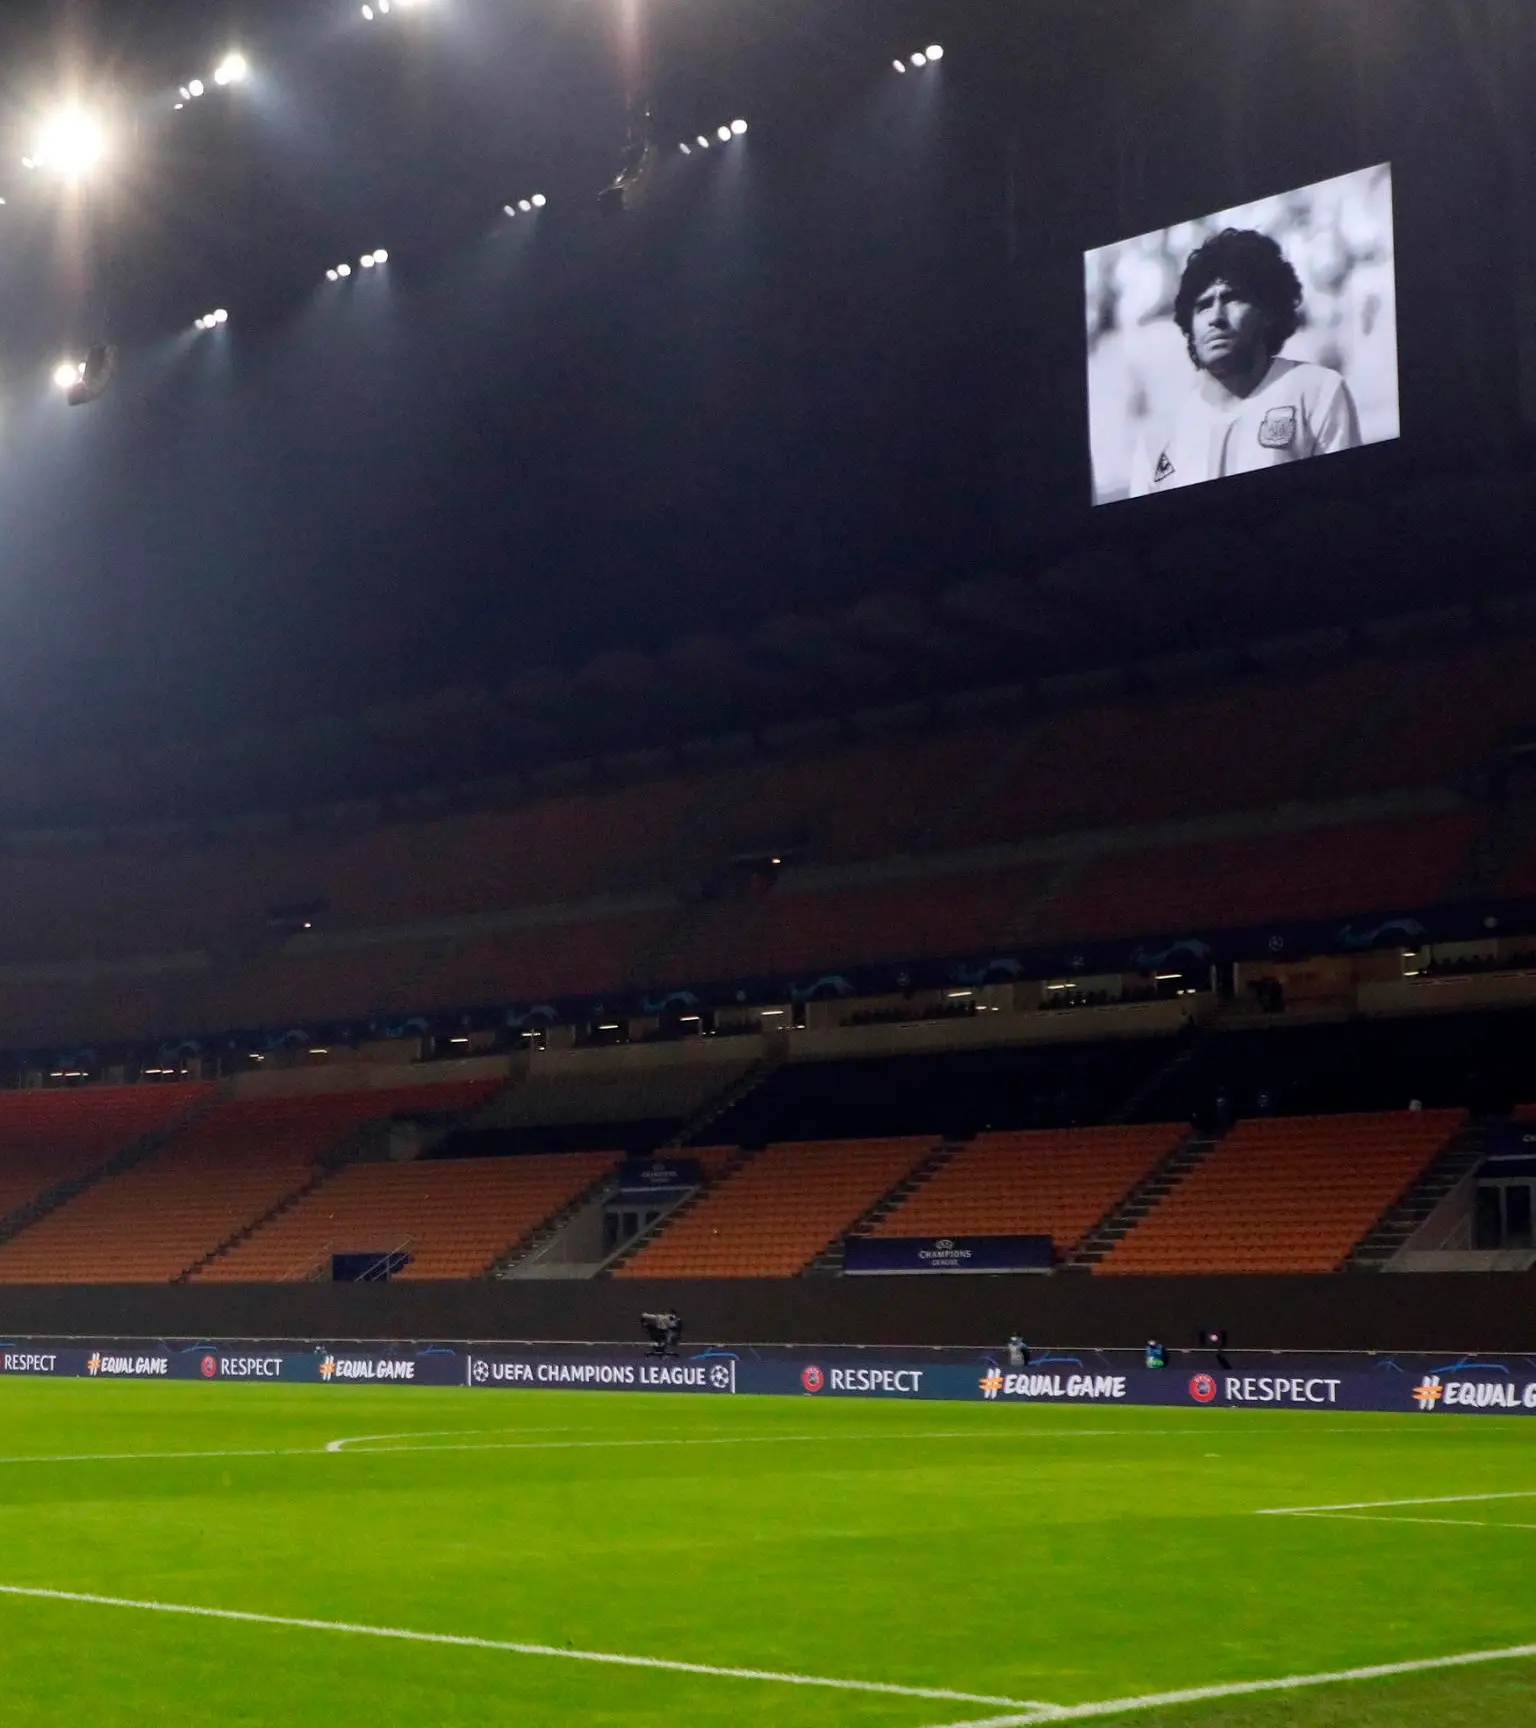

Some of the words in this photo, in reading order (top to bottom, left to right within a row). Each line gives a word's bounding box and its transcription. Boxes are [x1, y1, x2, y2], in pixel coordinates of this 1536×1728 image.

[4, 1354, 56, 1371] RESPECT
[220, 1357, 282, 1377] RESPECT
[492, 1362, 534, 1382] UEFA
[537, 1363, 633, 1384] CHAMPIONS
[640, 1366, 706, 1385] LEAGUE
[830, 1369, 923, 1392] RESPECT
[1224, 1376, 1341, 1402] RESPECT
